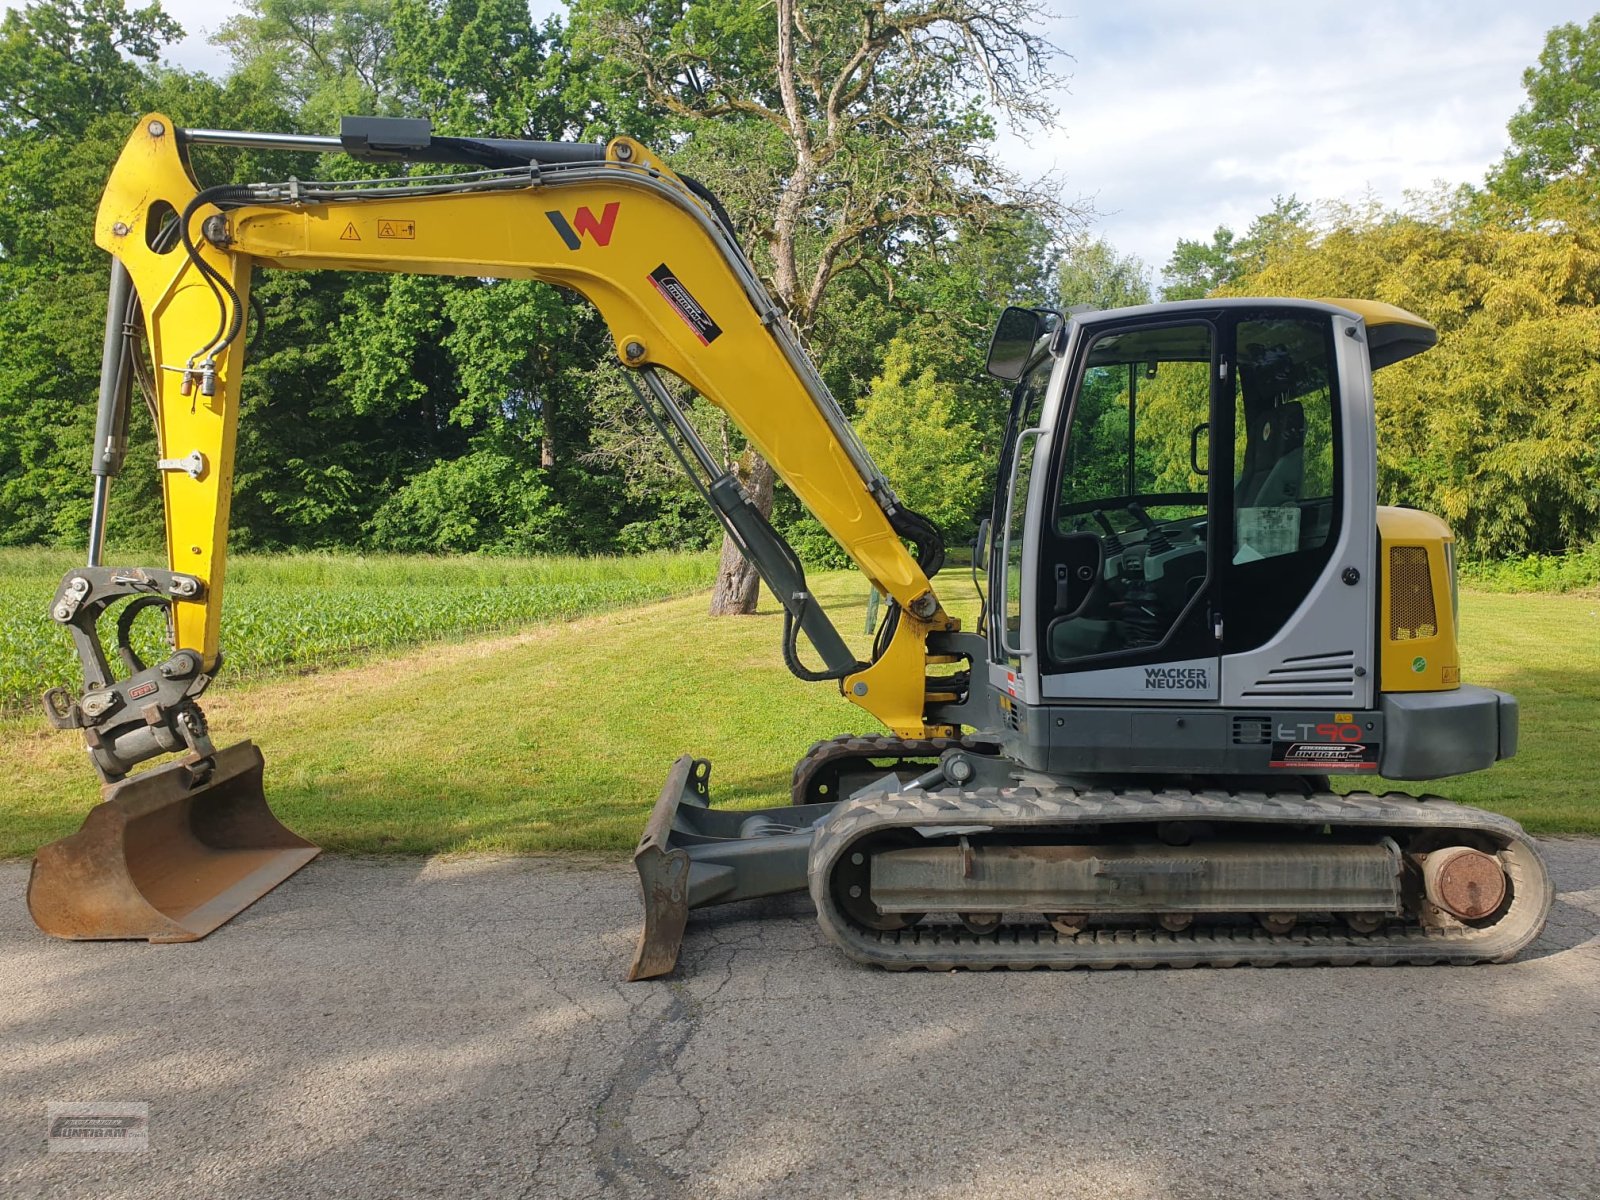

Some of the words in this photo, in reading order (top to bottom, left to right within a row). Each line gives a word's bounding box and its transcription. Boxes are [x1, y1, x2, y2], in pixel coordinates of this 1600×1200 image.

[1144, 668, 1207, 679] WACKER
[1145, 678, 1207, 689] NEUSON
[1277, 723, 1363, 742] ET90
